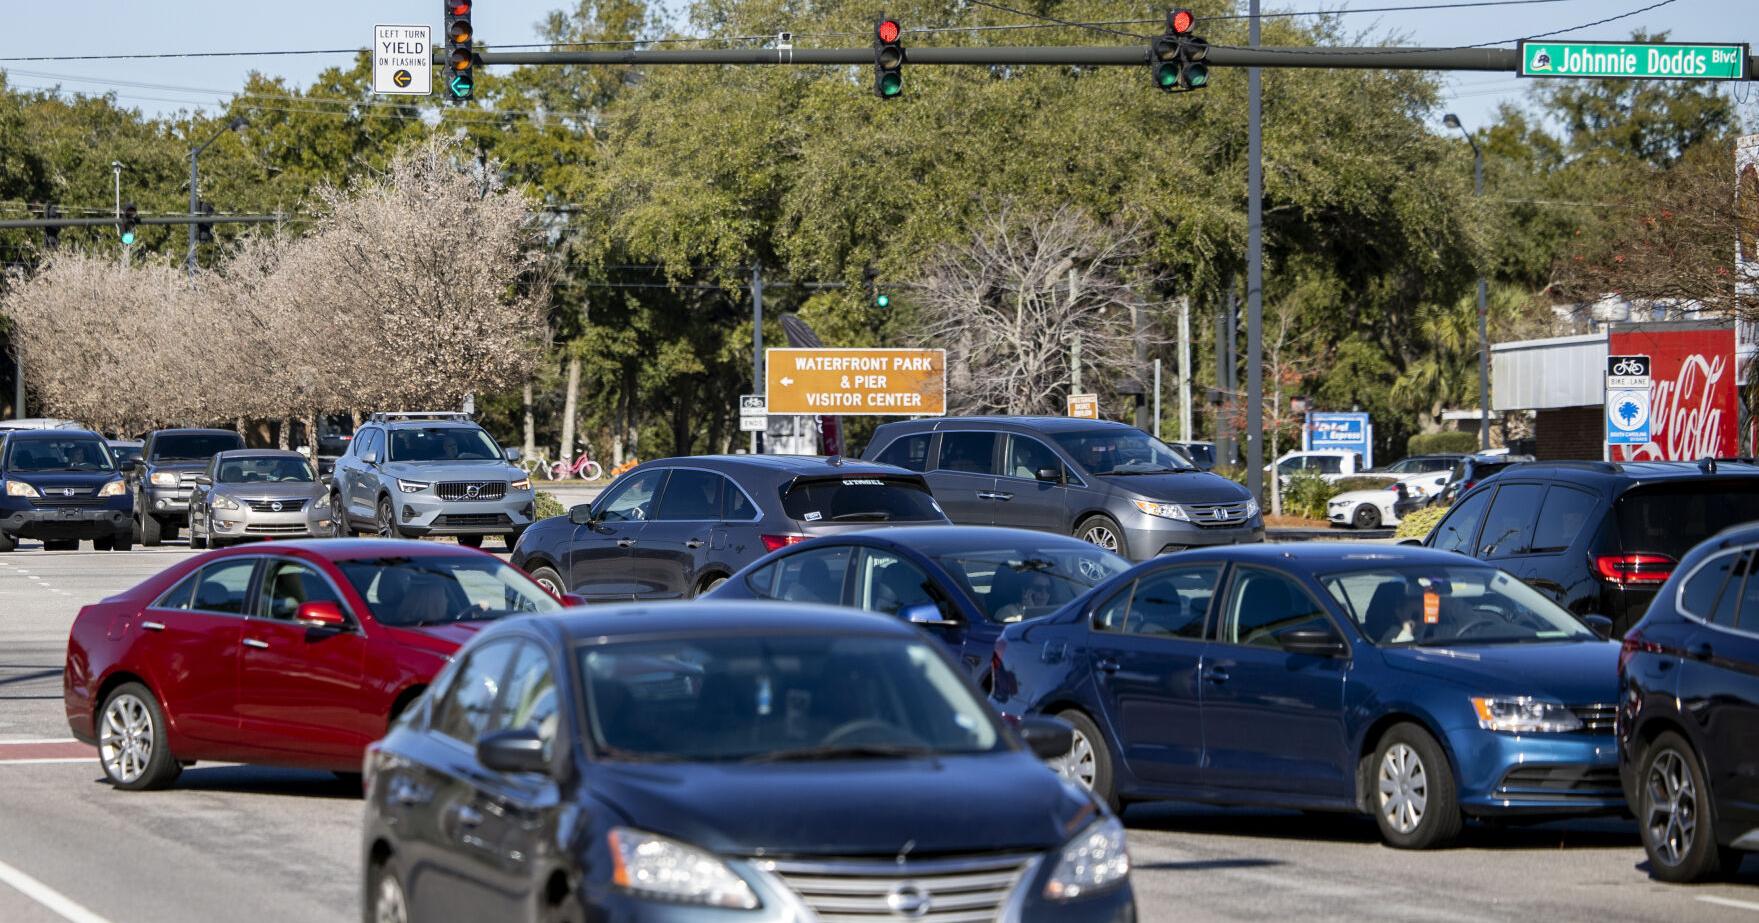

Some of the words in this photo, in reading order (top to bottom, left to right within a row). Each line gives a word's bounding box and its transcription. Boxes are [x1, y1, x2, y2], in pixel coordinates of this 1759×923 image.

[380, 30, 398, 38] LEFT
[405, 30, 426, 38] TURN
[382, 42, 424, 54] YIELD
[379, 57, 389, 66] ON
[392, 57, 426, 67] FLASHING
[1557, 47, 1637, 74] Johnnie
[1648, 48, 1706, 75] Dodds
[1712, 50, 1737, 63] Blvd
[795, 357, 889, 371] WATERFRONT
[893, 357, 932, 371] PARK
[840, 375, 851, 388] &
[855, 375, 887, 388] PIER
[806, 393, 862, 406] VISITOR
[867, 393, 922, 406] CENTER
